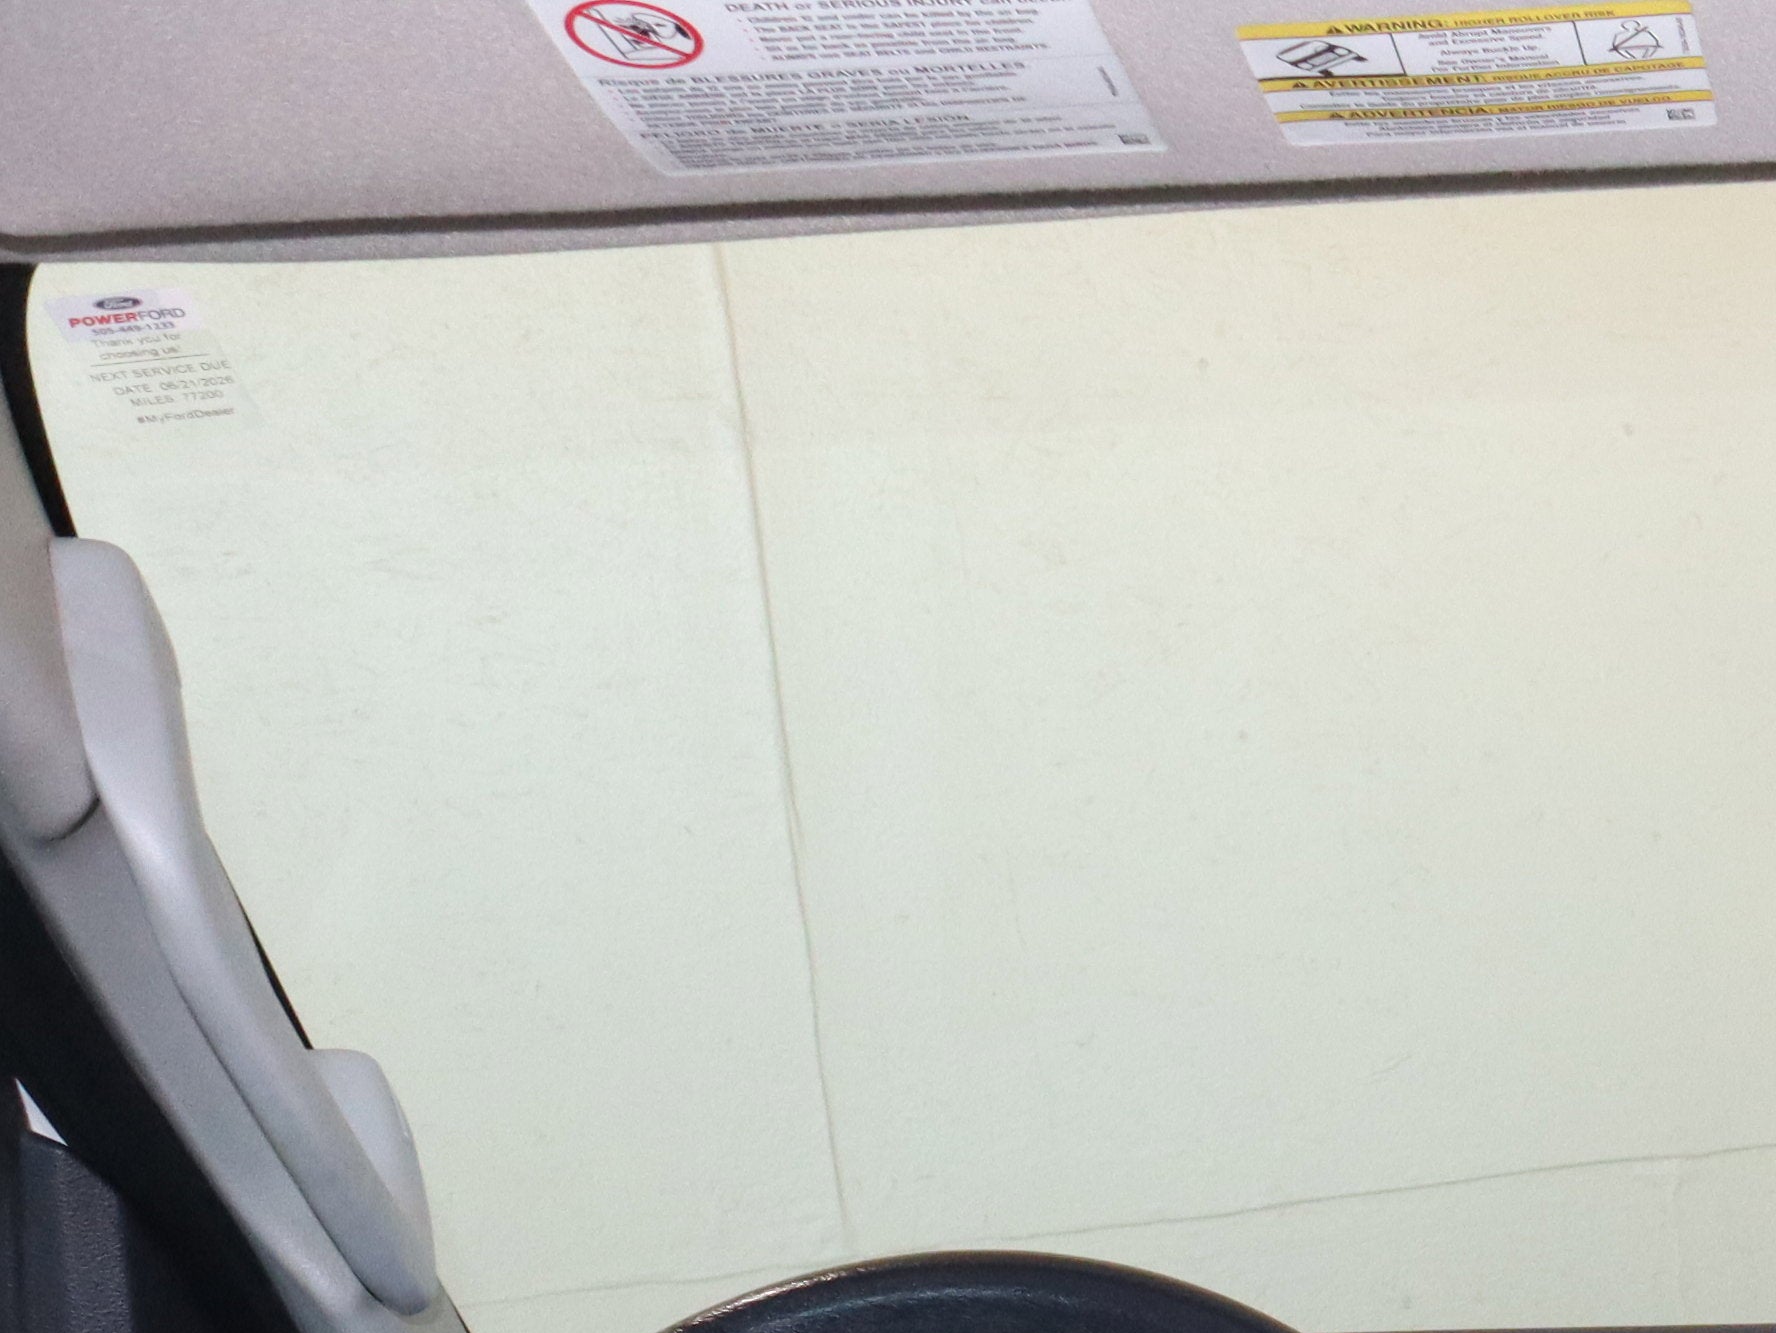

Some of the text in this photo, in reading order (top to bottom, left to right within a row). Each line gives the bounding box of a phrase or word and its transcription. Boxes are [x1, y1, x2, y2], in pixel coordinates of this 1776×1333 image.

[725, 2, 789, 12] DEATH
[90, 359, 232, 384] NEXT SERVICE DUE
